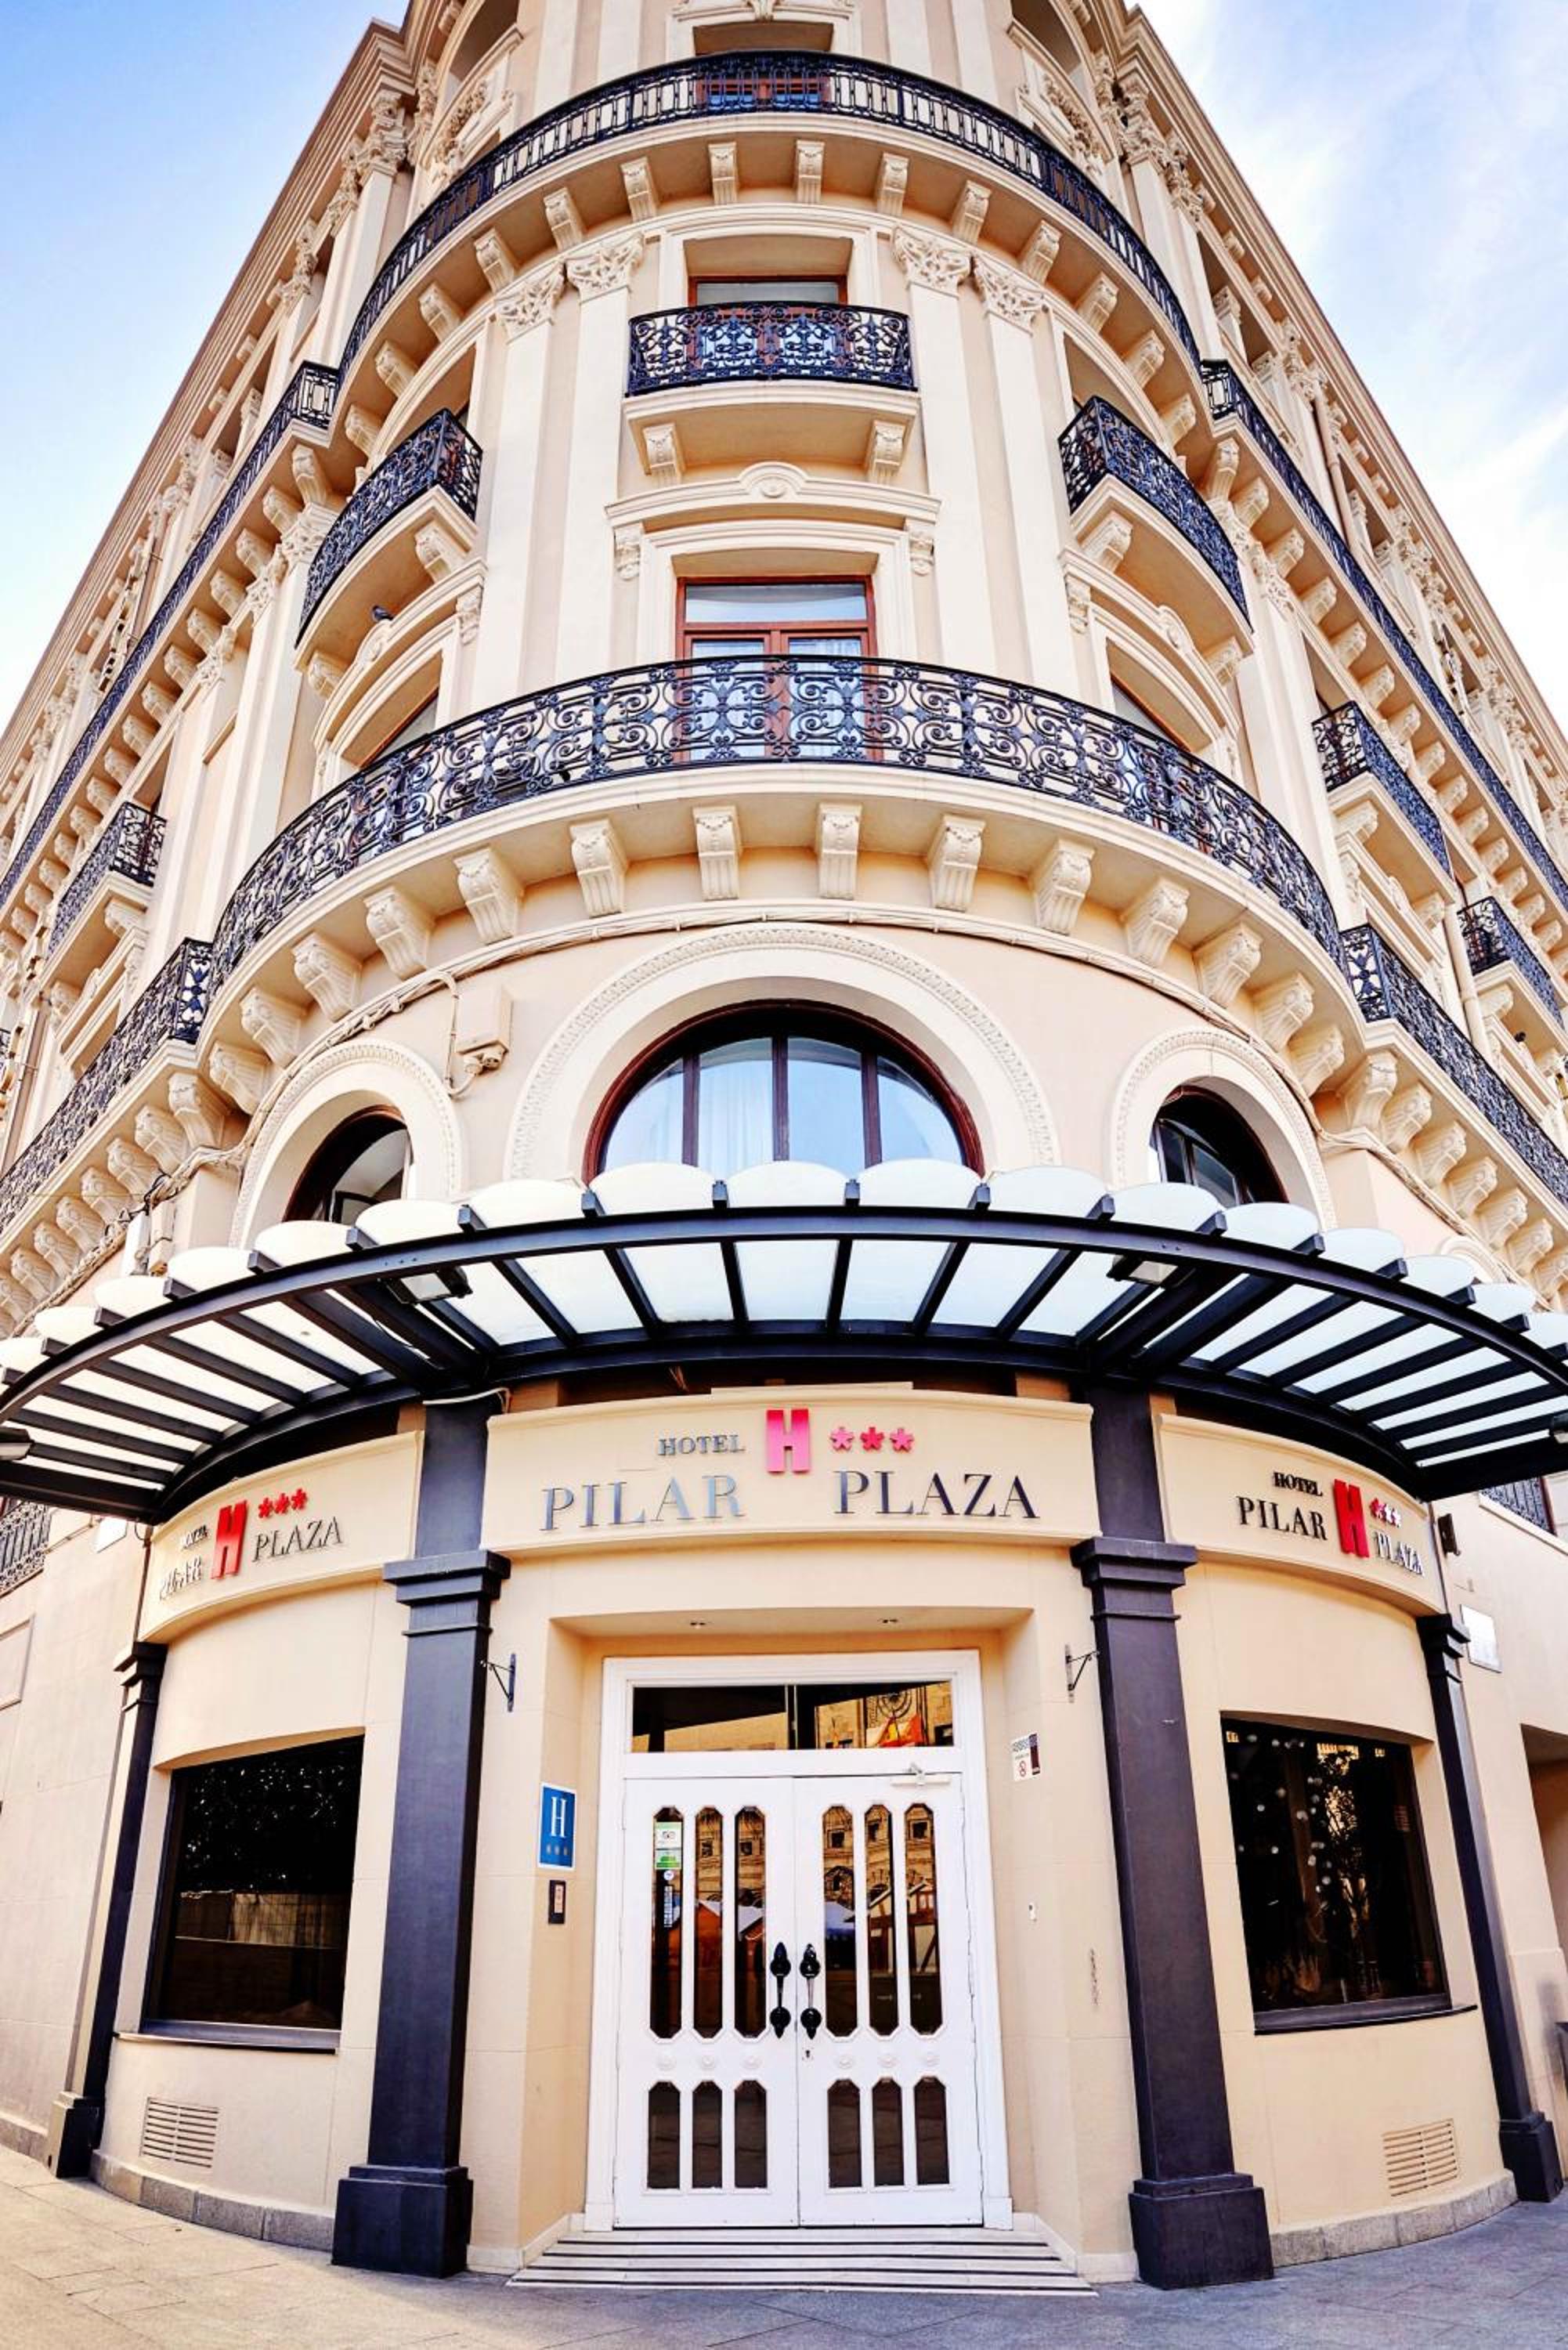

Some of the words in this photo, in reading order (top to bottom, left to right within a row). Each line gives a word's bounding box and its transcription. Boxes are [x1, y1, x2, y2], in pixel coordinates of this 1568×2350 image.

[658, 1434, 746, 1456] HOTEL
[766, 1408, 811, 1473] H
[540, 1473, 745, 1531] PILAR
[833, 1470, 1041, 1520] PLAZA
[1273, 1472, 1323, 1497] HOTEL
[211, 1499, 247, 1581] H
[251, 1516, 342, 1563] PLAZA
[1236, 1495, 1328, 1541] PILAR
[1374, 1529, 1424, 1576] PLAZA
[1333, 1478, 1369, 1558] H
[551, 1796, 567, 1838] H
